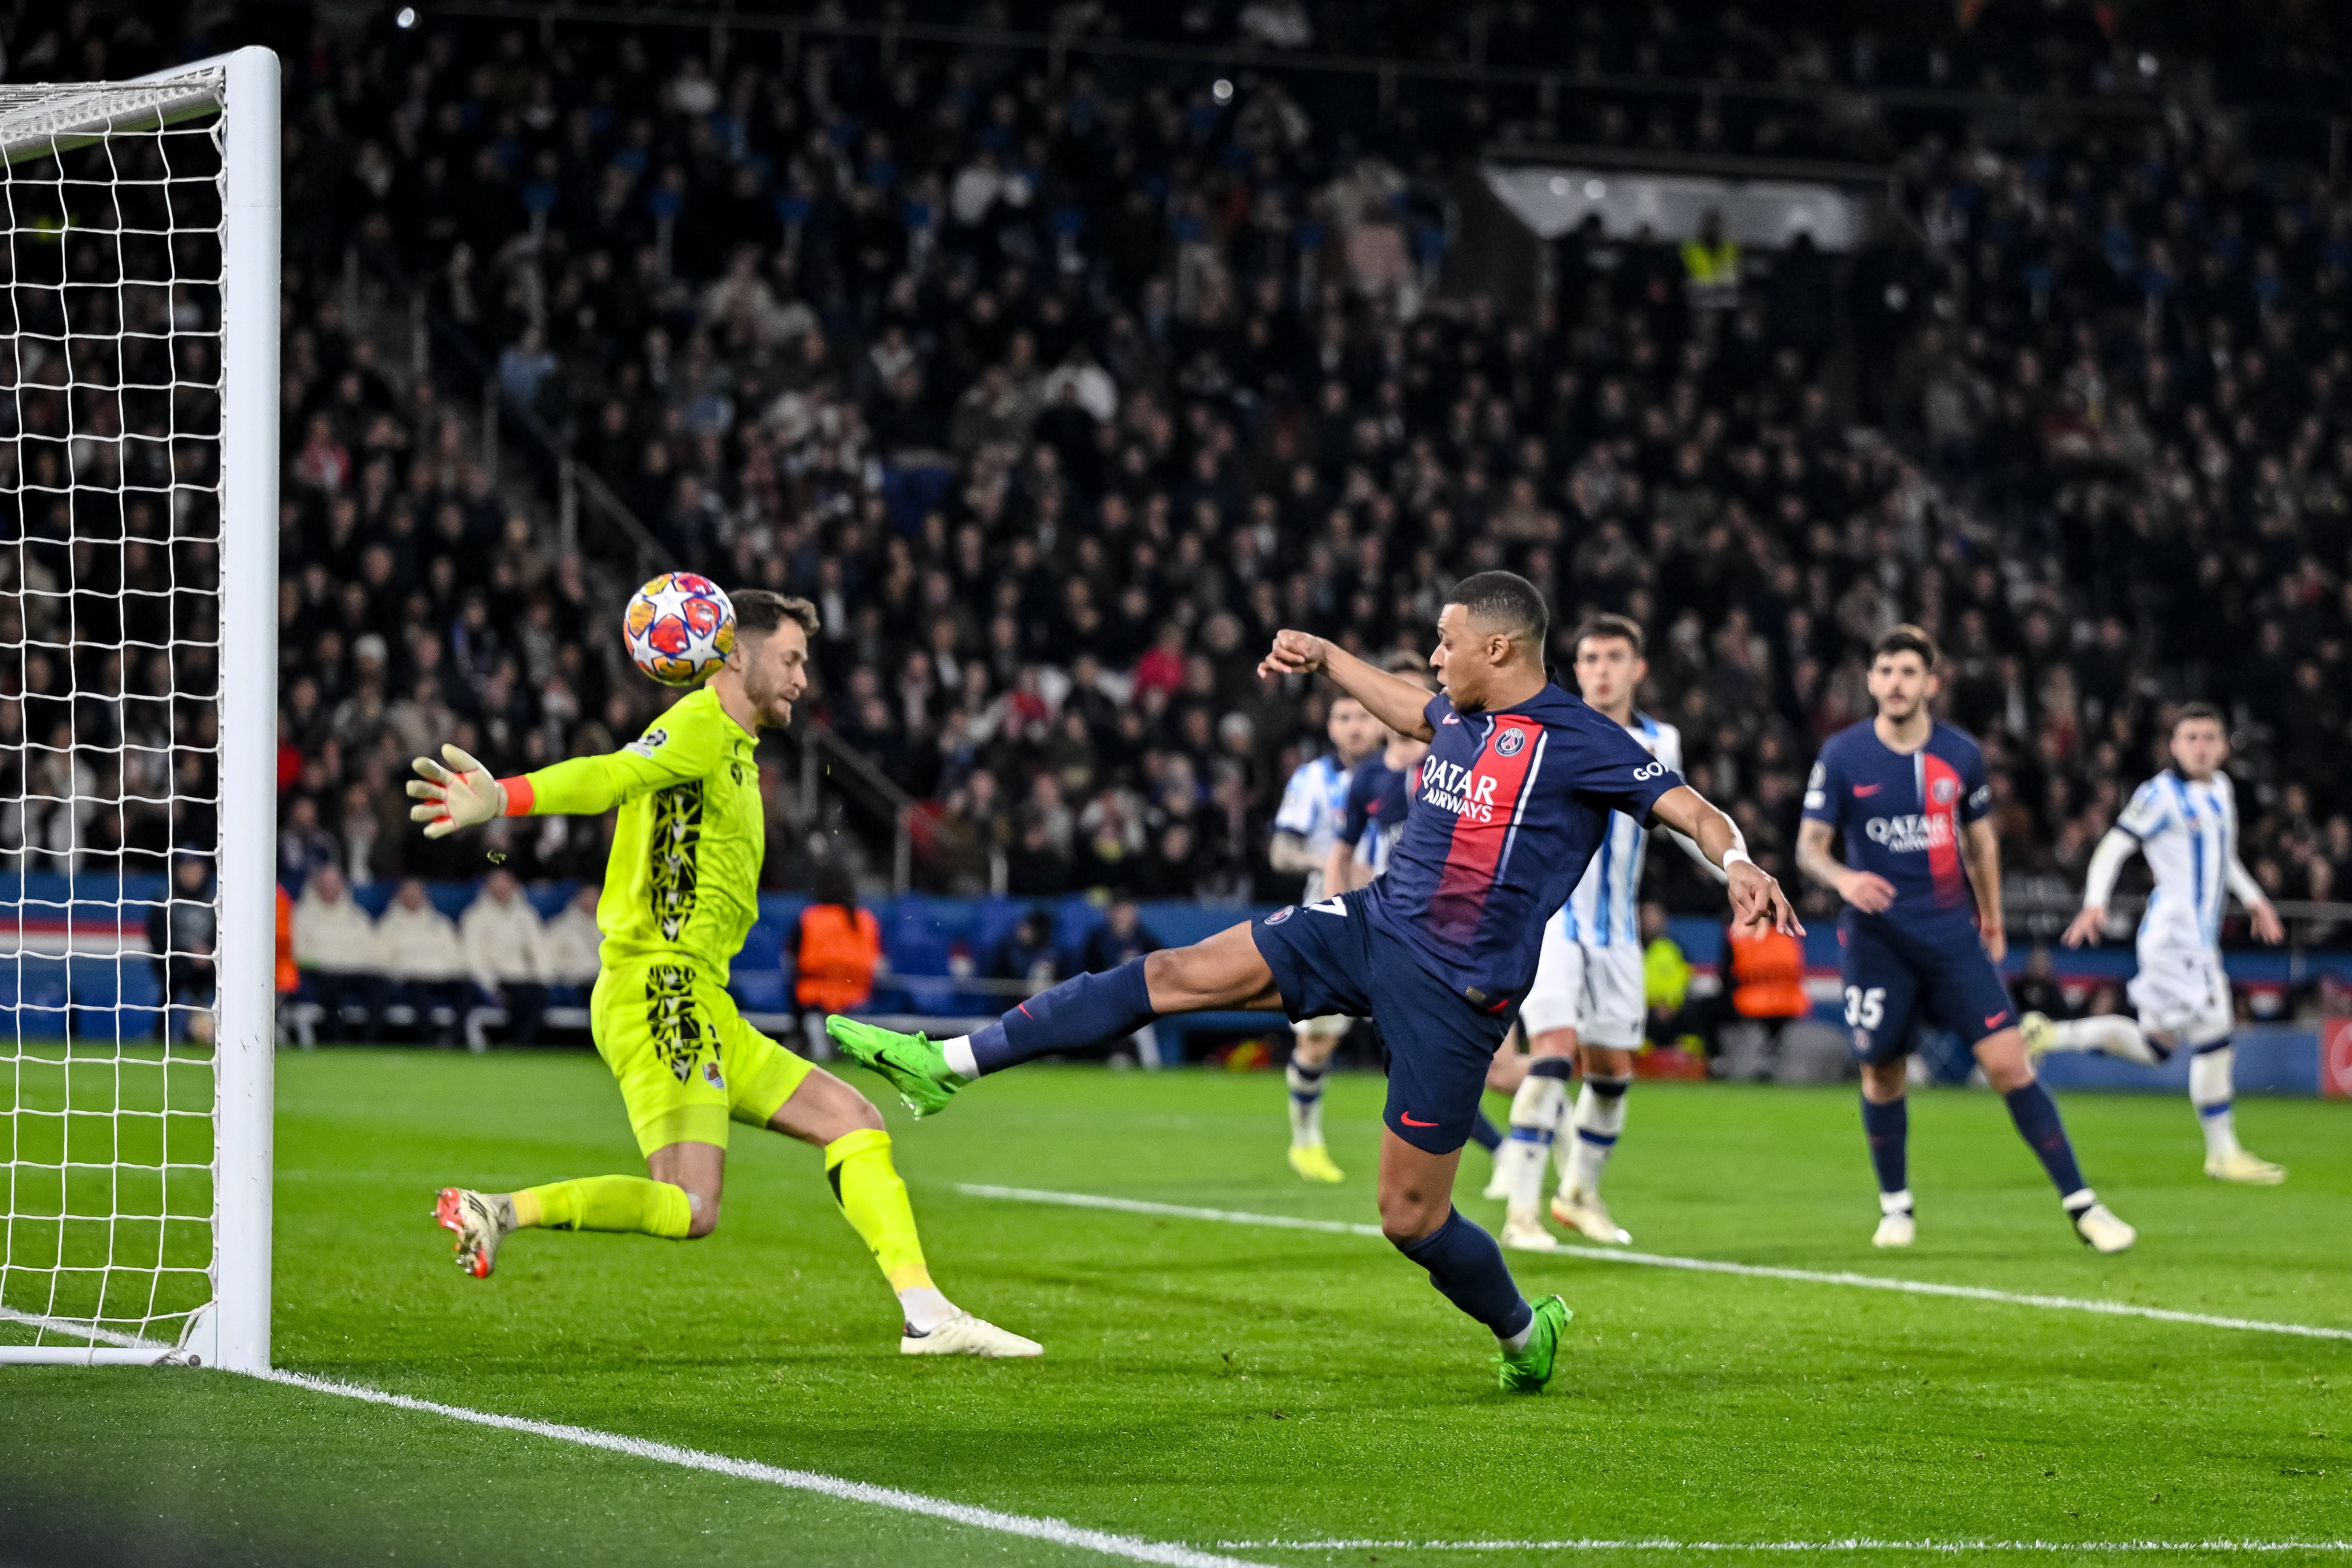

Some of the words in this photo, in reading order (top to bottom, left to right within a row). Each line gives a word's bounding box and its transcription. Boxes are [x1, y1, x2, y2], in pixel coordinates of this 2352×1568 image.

[1505, 730, 1523, 739] PARIS
[1422, 755, 1498, 806] QATAR
[1633, 762, 1669, 780] GO
[1422, 786, 1493, 823] AIRWAYS
[1865, 813, 1950, 845] QATAR
[1844, 985, 1886, 1030] 35
